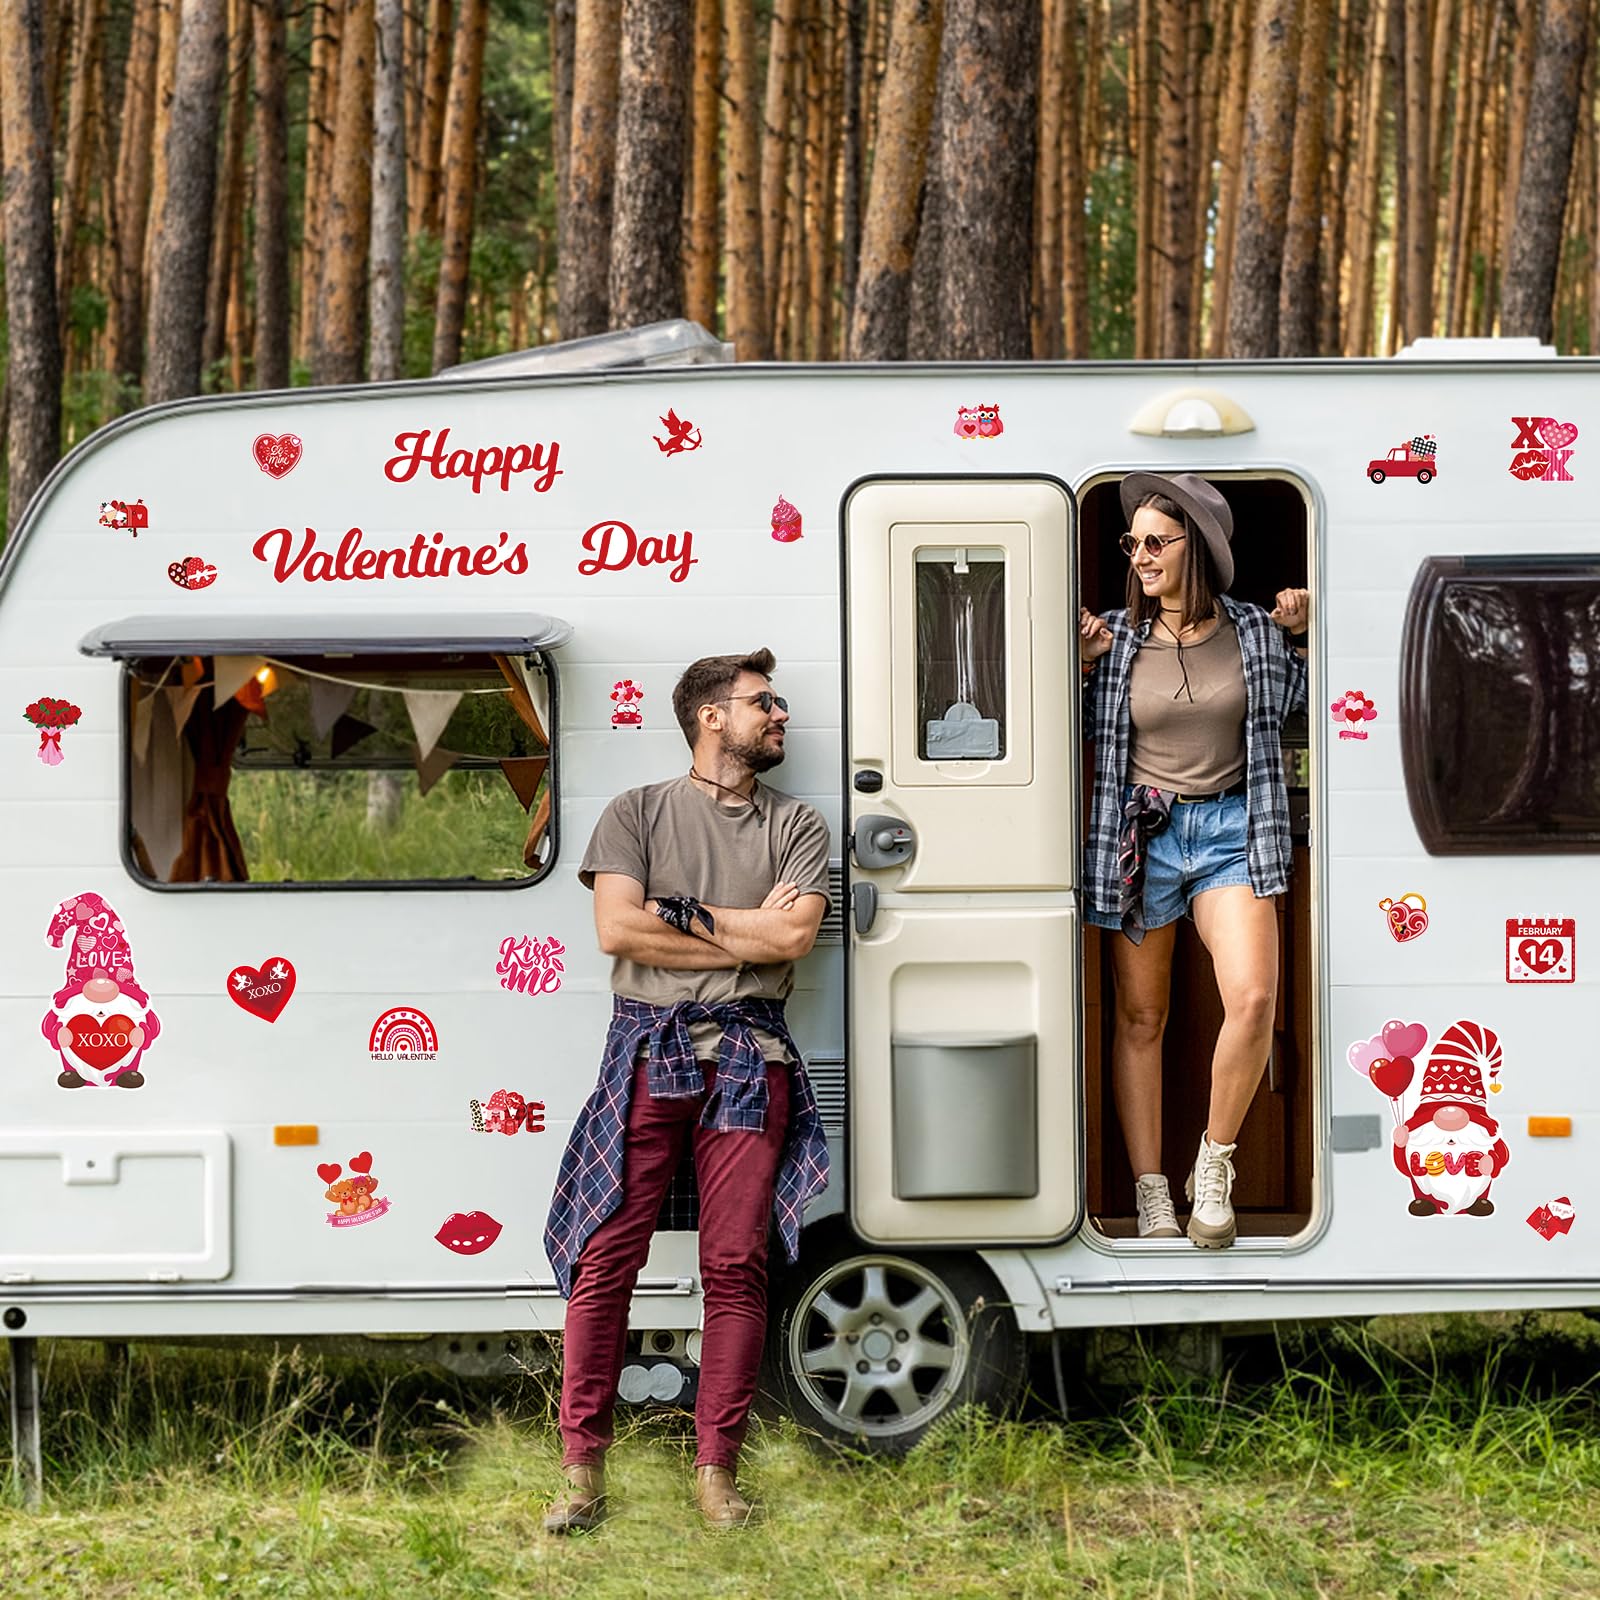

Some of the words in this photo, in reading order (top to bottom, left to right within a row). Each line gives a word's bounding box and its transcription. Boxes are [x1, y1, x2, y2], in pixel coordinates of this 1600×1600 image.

[384, 428, 563, 494] Happy
[577, 520, 698, 583] Day
[1517, 927, 1563, 936] FEBRUARY
[76, 951, 123, 968] LOVE
[499, 935, 566, 971] Kiss
[1524, 944, 1557, 966] 14
[247, 982, 282, 1000] XOXO
[77, 1032, 128, 1048] XOXO
[371, 1053, 394, 1061] HELLO
[397, 1053, 437, 1061] VALENTINE
[1410, 1151, 1485, 1177] LOVE
